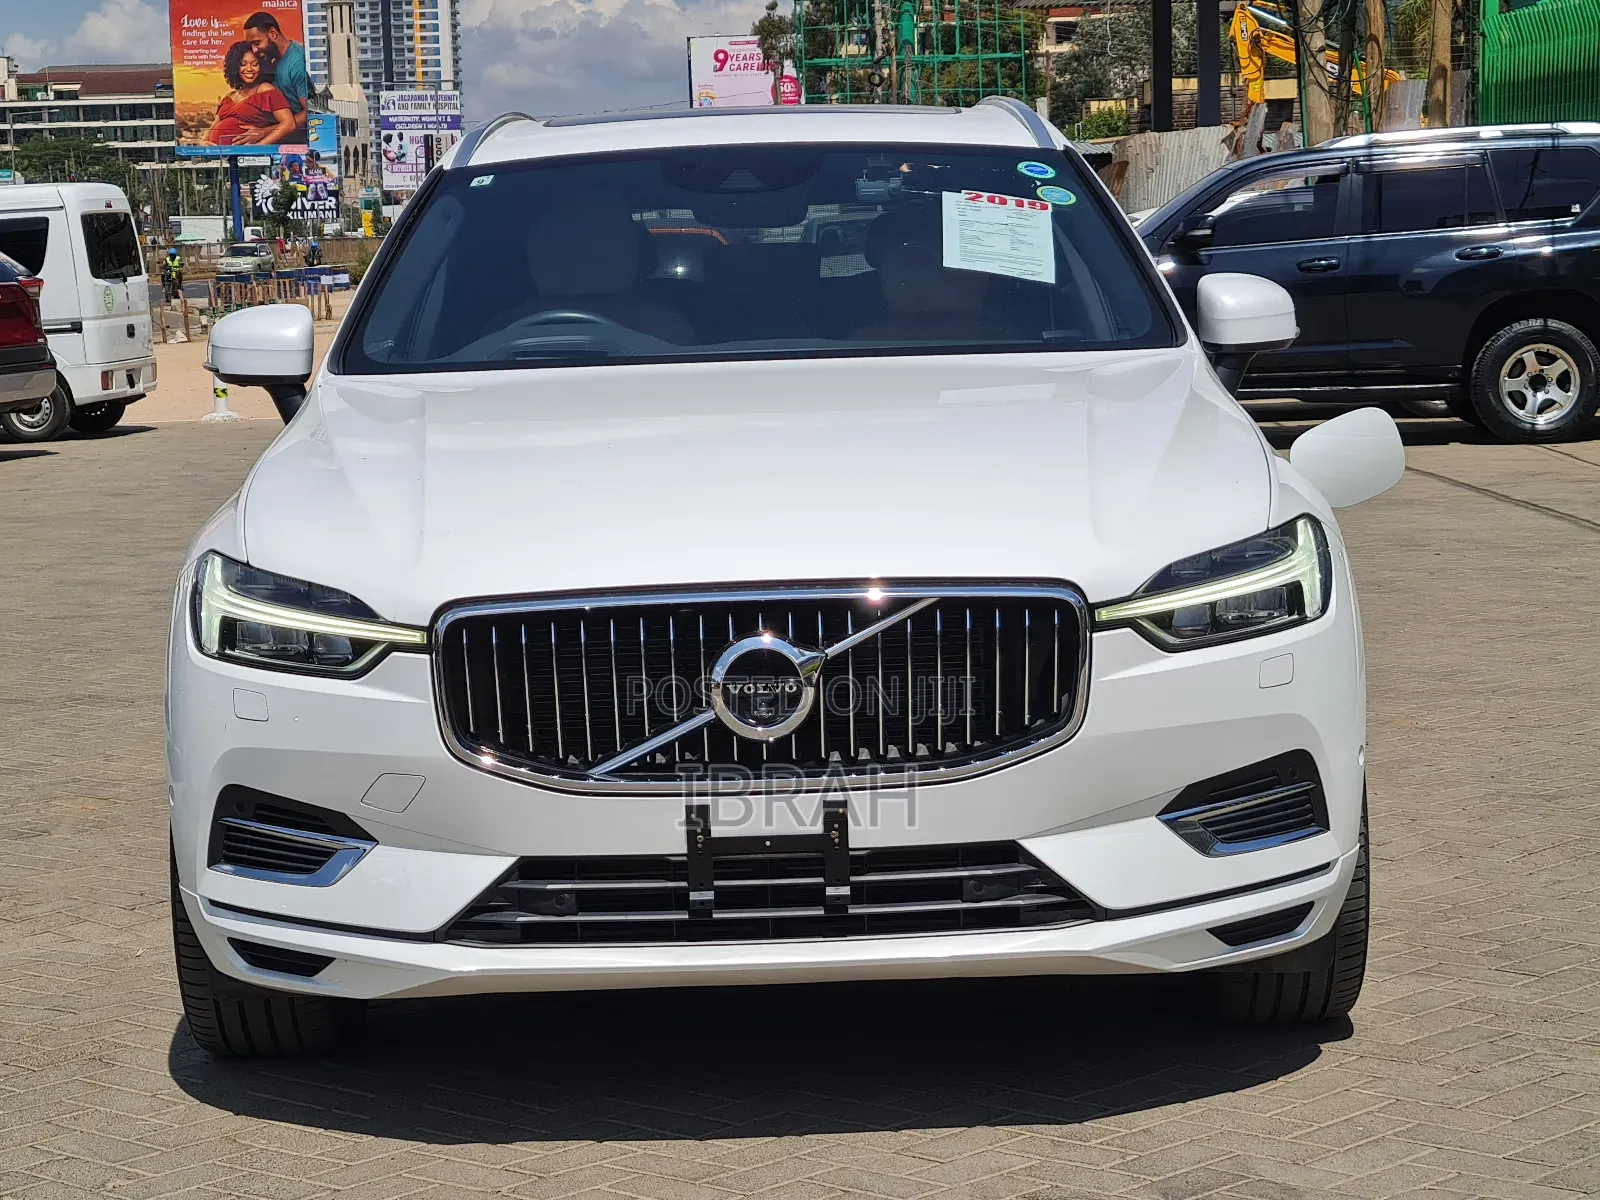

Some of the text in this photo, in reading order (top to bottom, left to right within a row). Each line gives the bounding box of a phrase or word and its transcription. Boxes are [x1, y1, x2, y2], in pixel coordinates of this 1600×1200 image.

[181, 14, 208, 28] Love
[182, 30, 206, 38] finding
[713, 49, 729, 72] 9
[728, 53, 762, 62] YEARS
[397, 102, 409, 110] AND
[410, 102, 431, 110] FAMILY
[963, 191, 1049, 211] 2019
[726, 683, 798, 694] VOLVO
